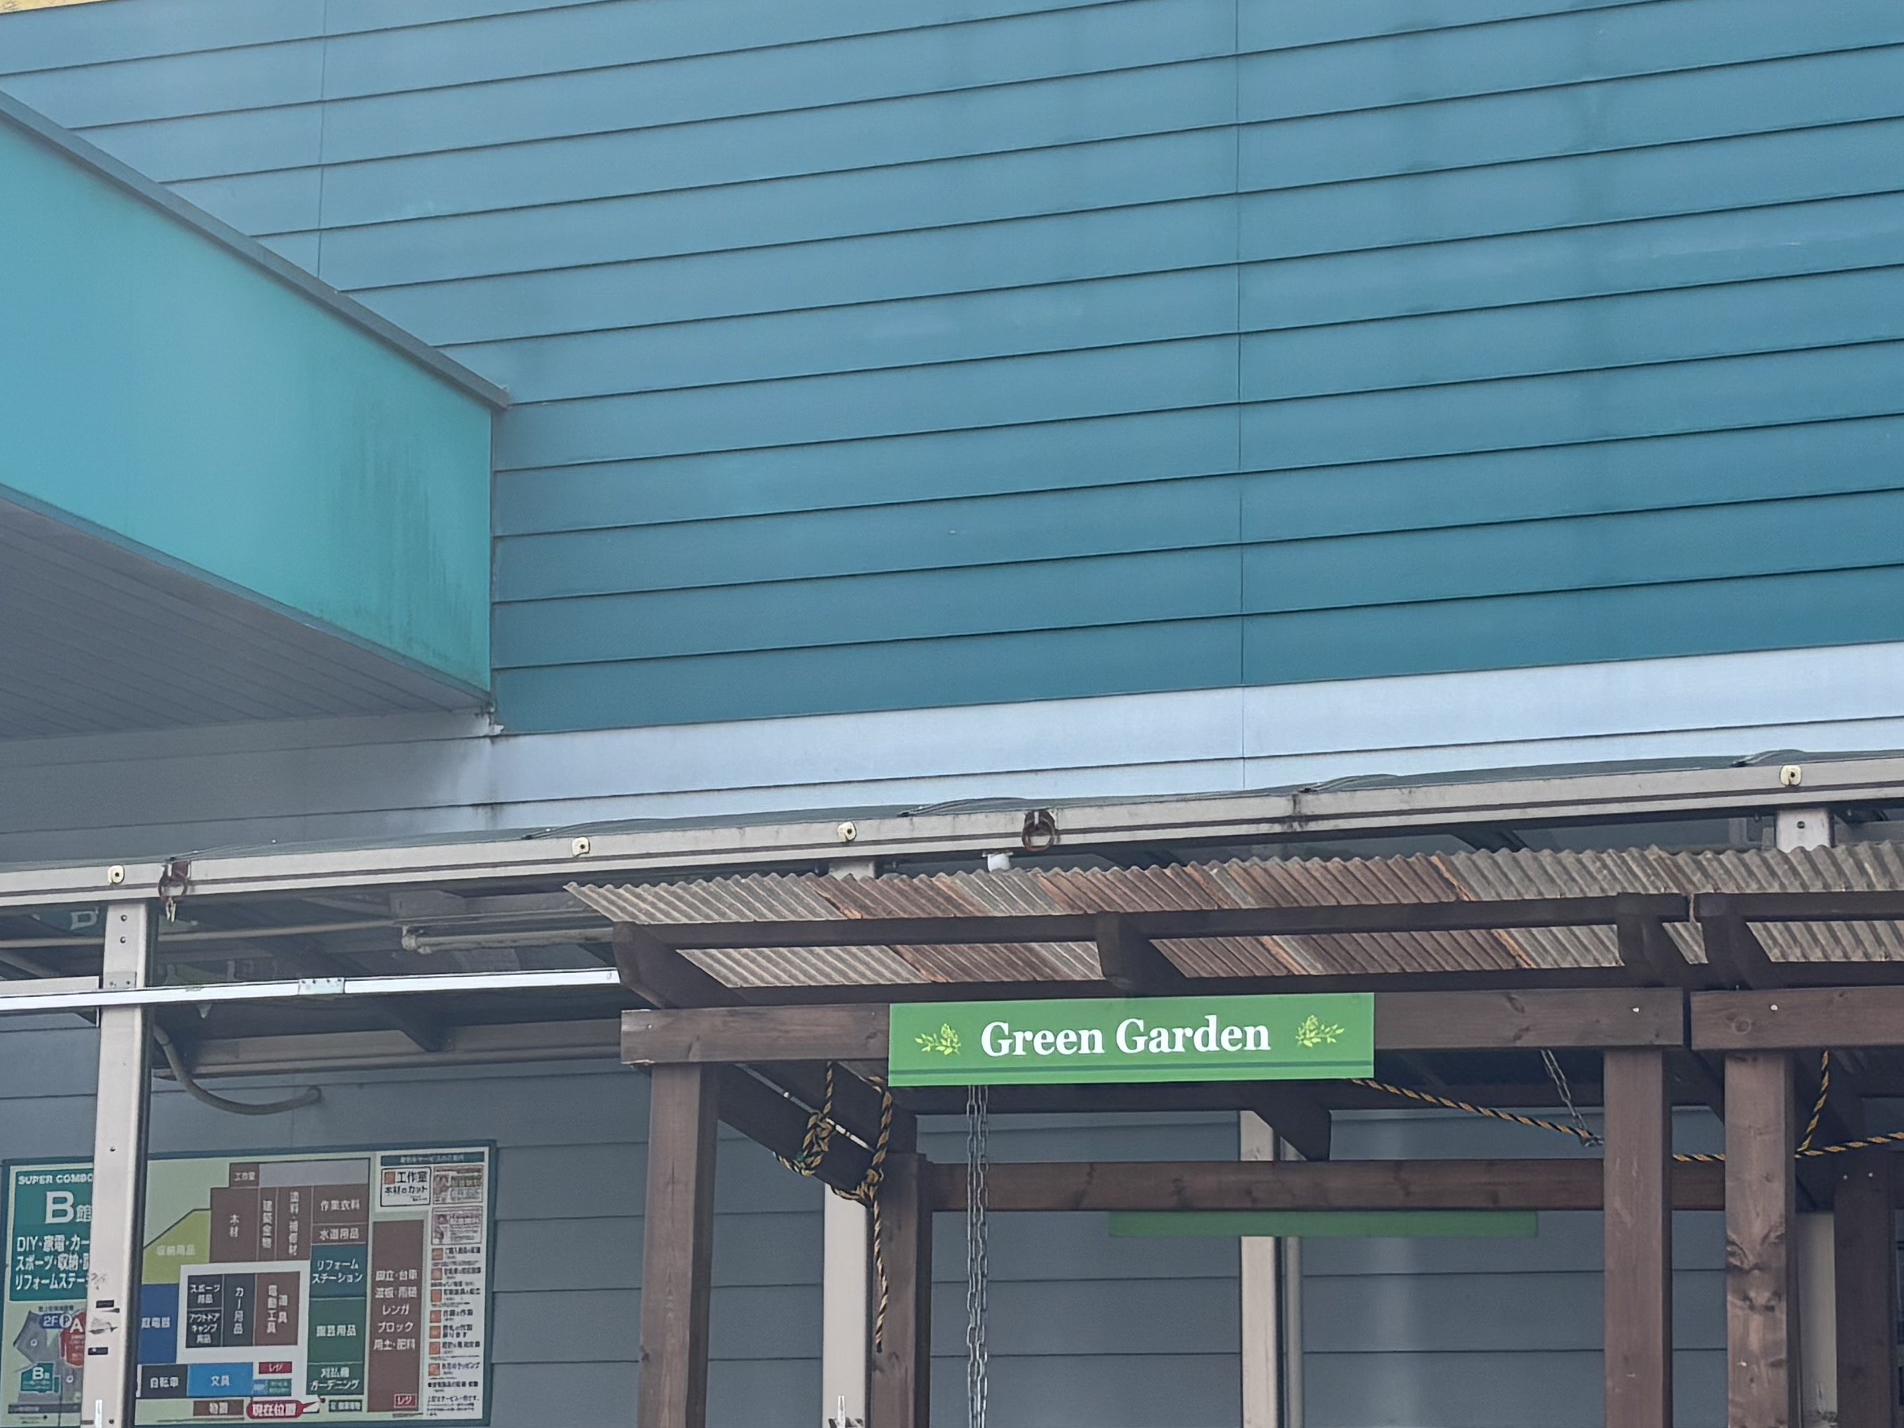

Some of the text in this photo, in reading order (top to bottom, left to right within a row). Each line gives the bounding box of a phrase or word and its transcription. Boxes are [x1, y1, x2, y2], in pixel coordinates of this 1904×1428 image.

[981, 1014, 1271, 1058] Green Garden
[18, 1175, 53, 1185] SUPER
[15, 1273, 88, 1290] リフォームステー
[382, 1304, 410, 1315] レンガ
[43, 1316, 58, 1327] 2F
[377, 1322, 414, 1333] ブロック
[211, 1375, 230, 1386] 文具
[310, 1379, 360, 1391] ガーデニング
